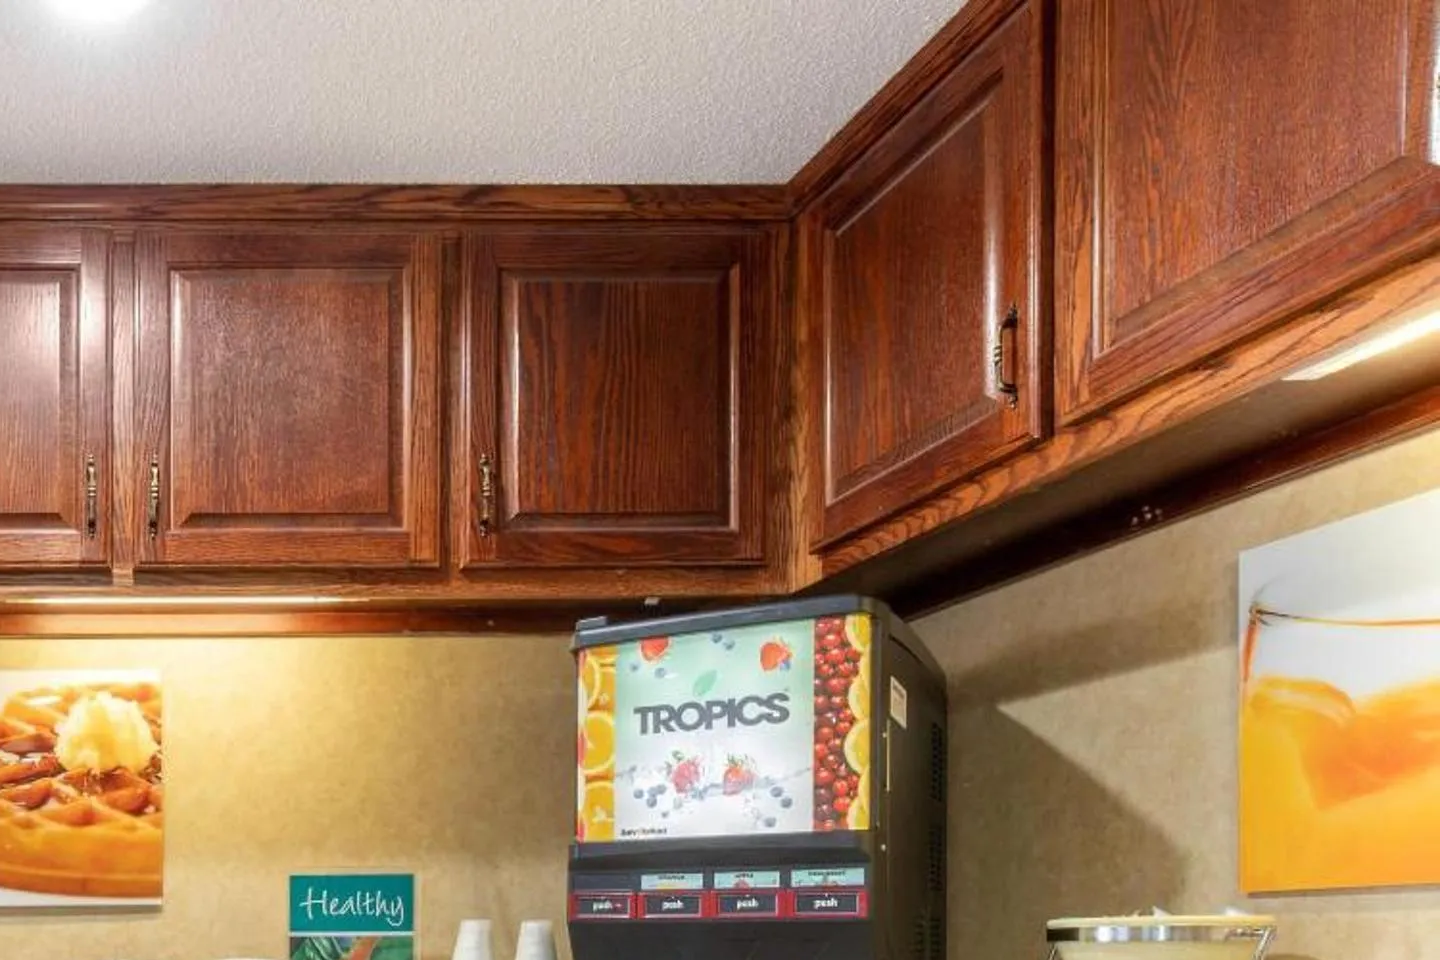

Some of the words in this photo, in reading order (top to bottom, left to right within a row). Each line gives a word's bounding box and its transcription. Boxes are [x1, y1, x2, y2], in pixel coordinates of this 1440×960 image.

[633, 692, 791, 736] TROPICS
[299, 886, 405, 927] Healthy
[736, 898, 759, 910] push
[813, 896, 839, 910] push
